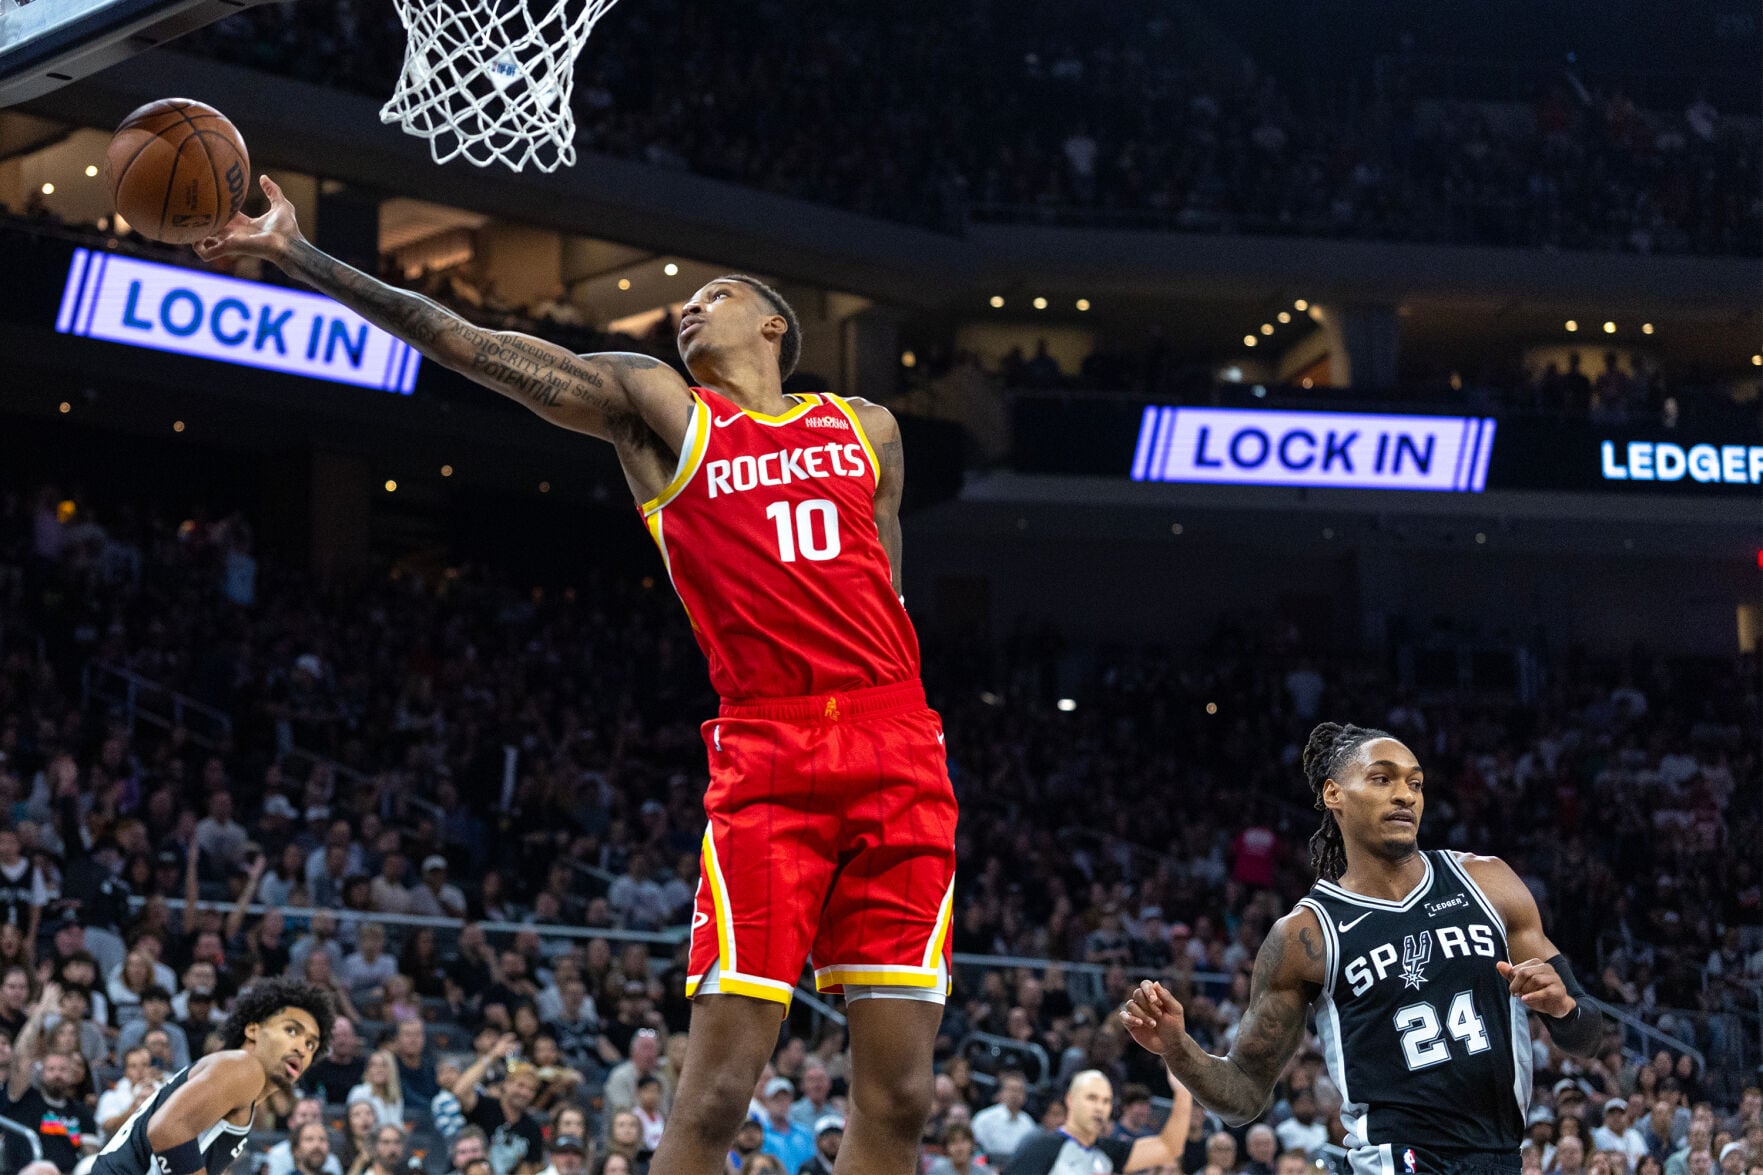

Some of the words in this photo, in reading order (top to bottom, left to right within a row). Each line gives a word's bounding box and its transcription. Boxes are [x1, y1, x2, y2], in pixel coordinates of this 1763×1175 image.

[121, 279, 293, 355] LOCK
[305, 314, 369, 369] IN
[451, 324, 544, 376] MEDIOCRITY
[543, 370, 572, 391] And
[473, 353, 564, 407] POTENTIAL
[559, 356, 604, 388] Breeds
[706, 442, 865, 499] ROCKETS
[1193, 425, 1361, 475] LOCK
[1374, 432, 1436, 476] IN
[766, 499, 841, 562] 10
[1430, 897, 1462, 912] LEDGER
[1392, 990, 1491, 1071] 24
